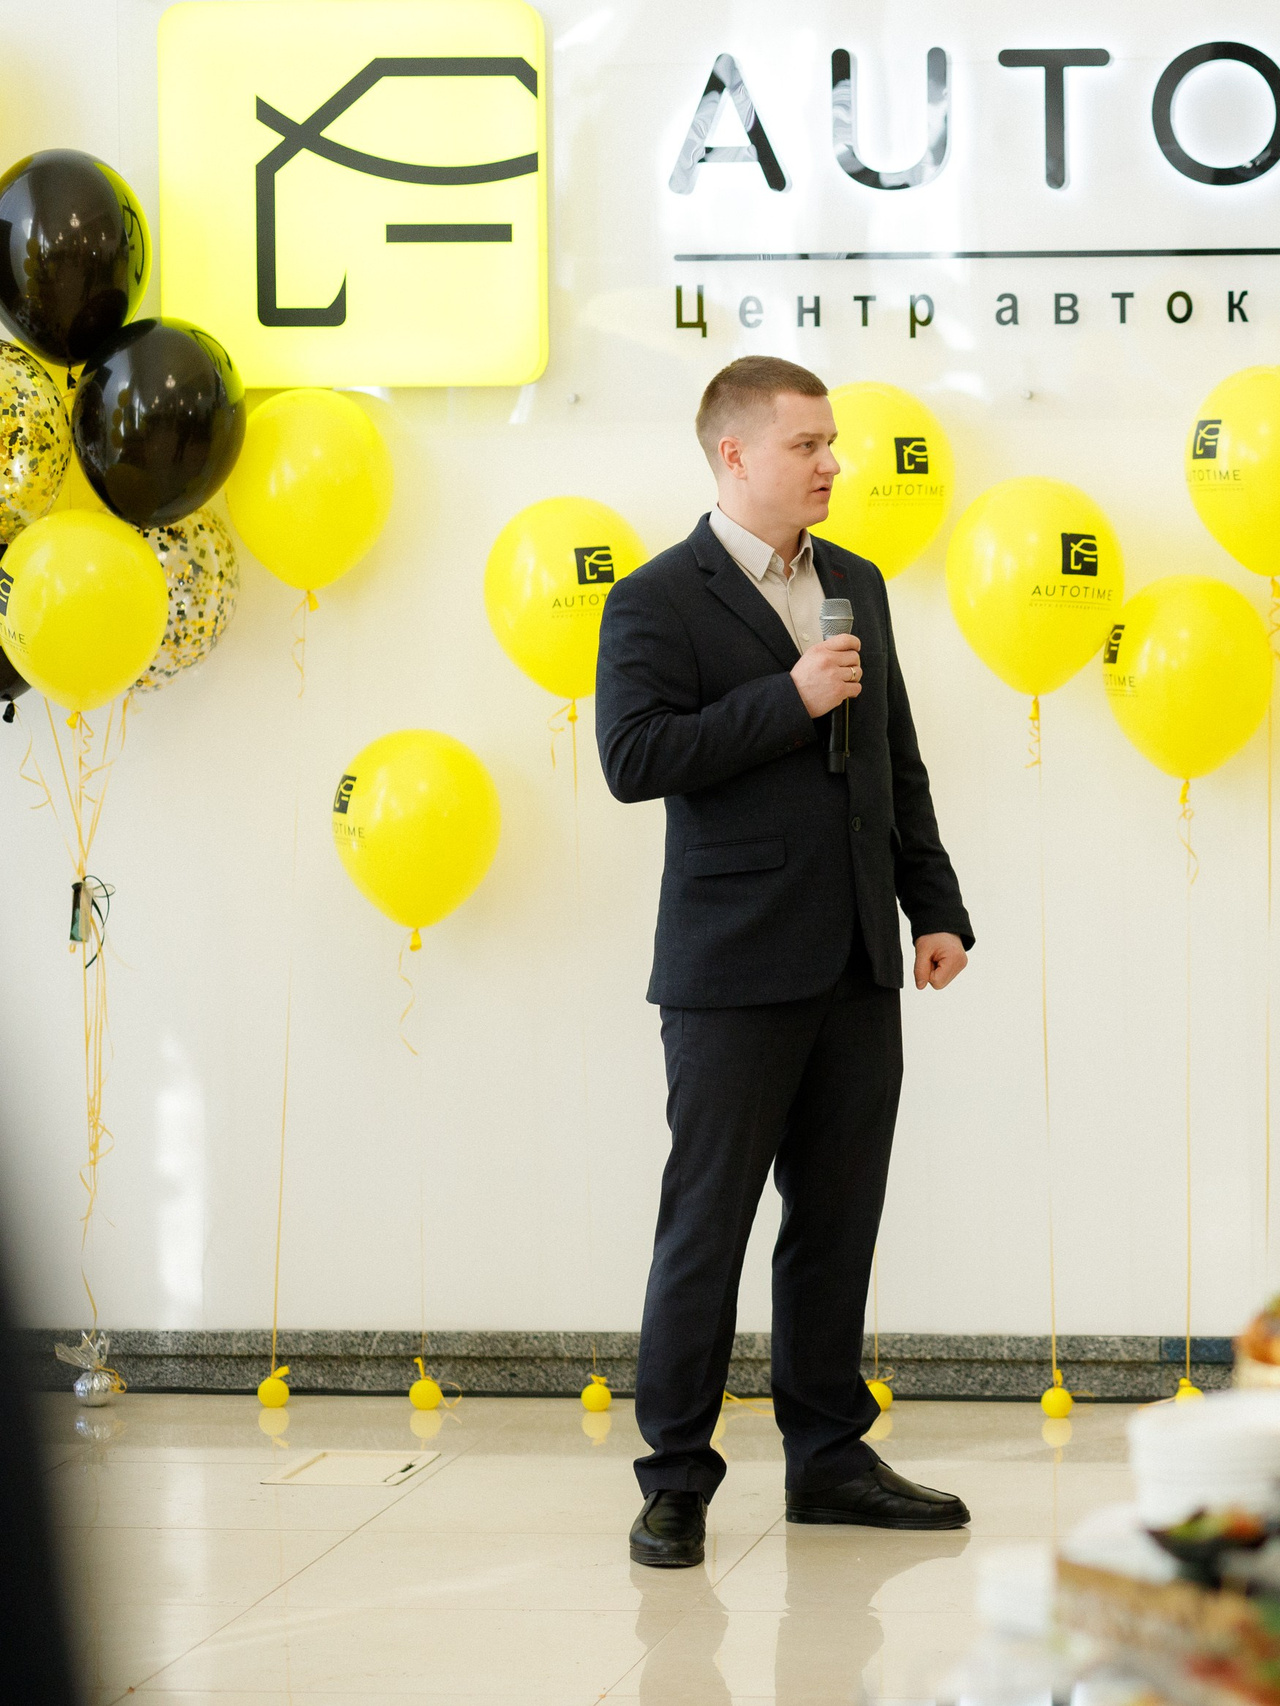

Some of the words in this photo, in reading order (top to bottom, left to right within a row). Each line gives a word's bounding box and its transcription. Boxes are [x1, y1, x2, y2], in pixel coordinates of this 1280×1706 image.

[675, 284, 935, 338] Центр
[870, 484, 945, 497] AUTOTIME
[552, 593, 608, 608] AUTOT
[1031, 585, 1113, 601] AUTOTIME
